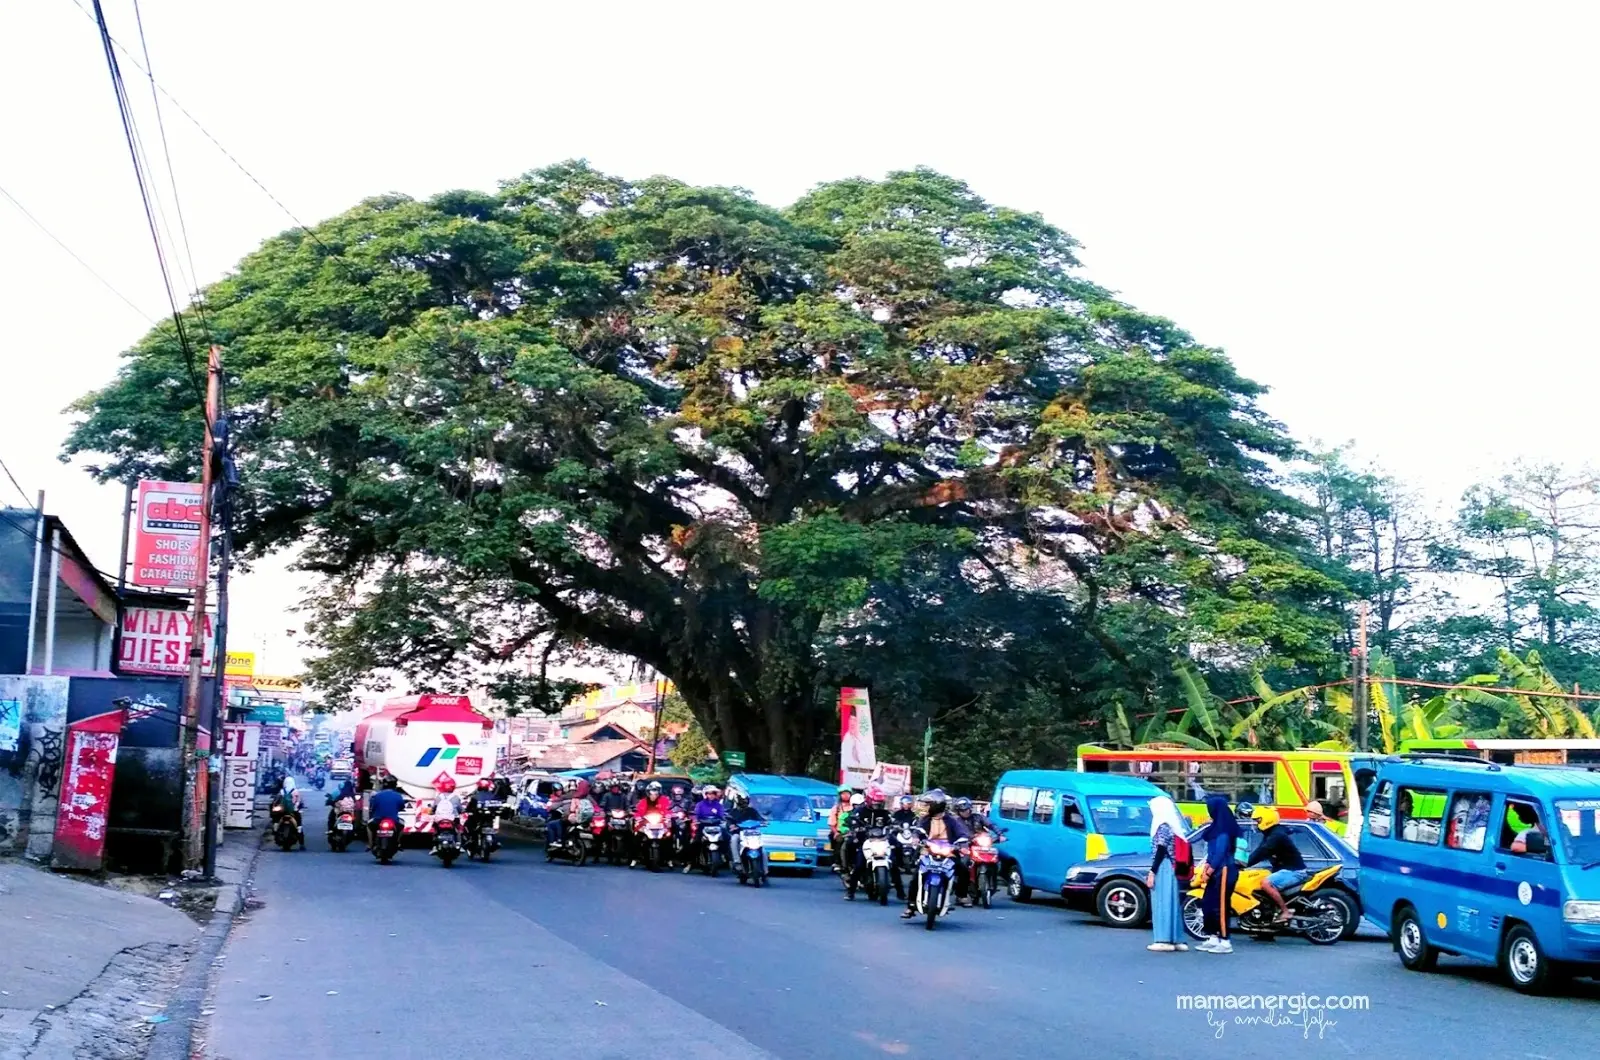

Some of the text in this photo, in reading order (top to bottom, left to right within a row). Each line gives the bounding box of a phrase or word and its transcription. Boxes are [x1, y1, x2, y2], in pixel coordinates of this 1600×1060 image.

[147, 497, 203, 522] abc
[172, 522, 199, 530] SHOES
[155, 539, 192, 551] SHOES
[148, 553, 197, 566] FASHION
[140, 567, 197, 581] CATALOGU
[123, 608, 213, 638] WIJAYA
[230, 764, 249, 816] MOBIL
